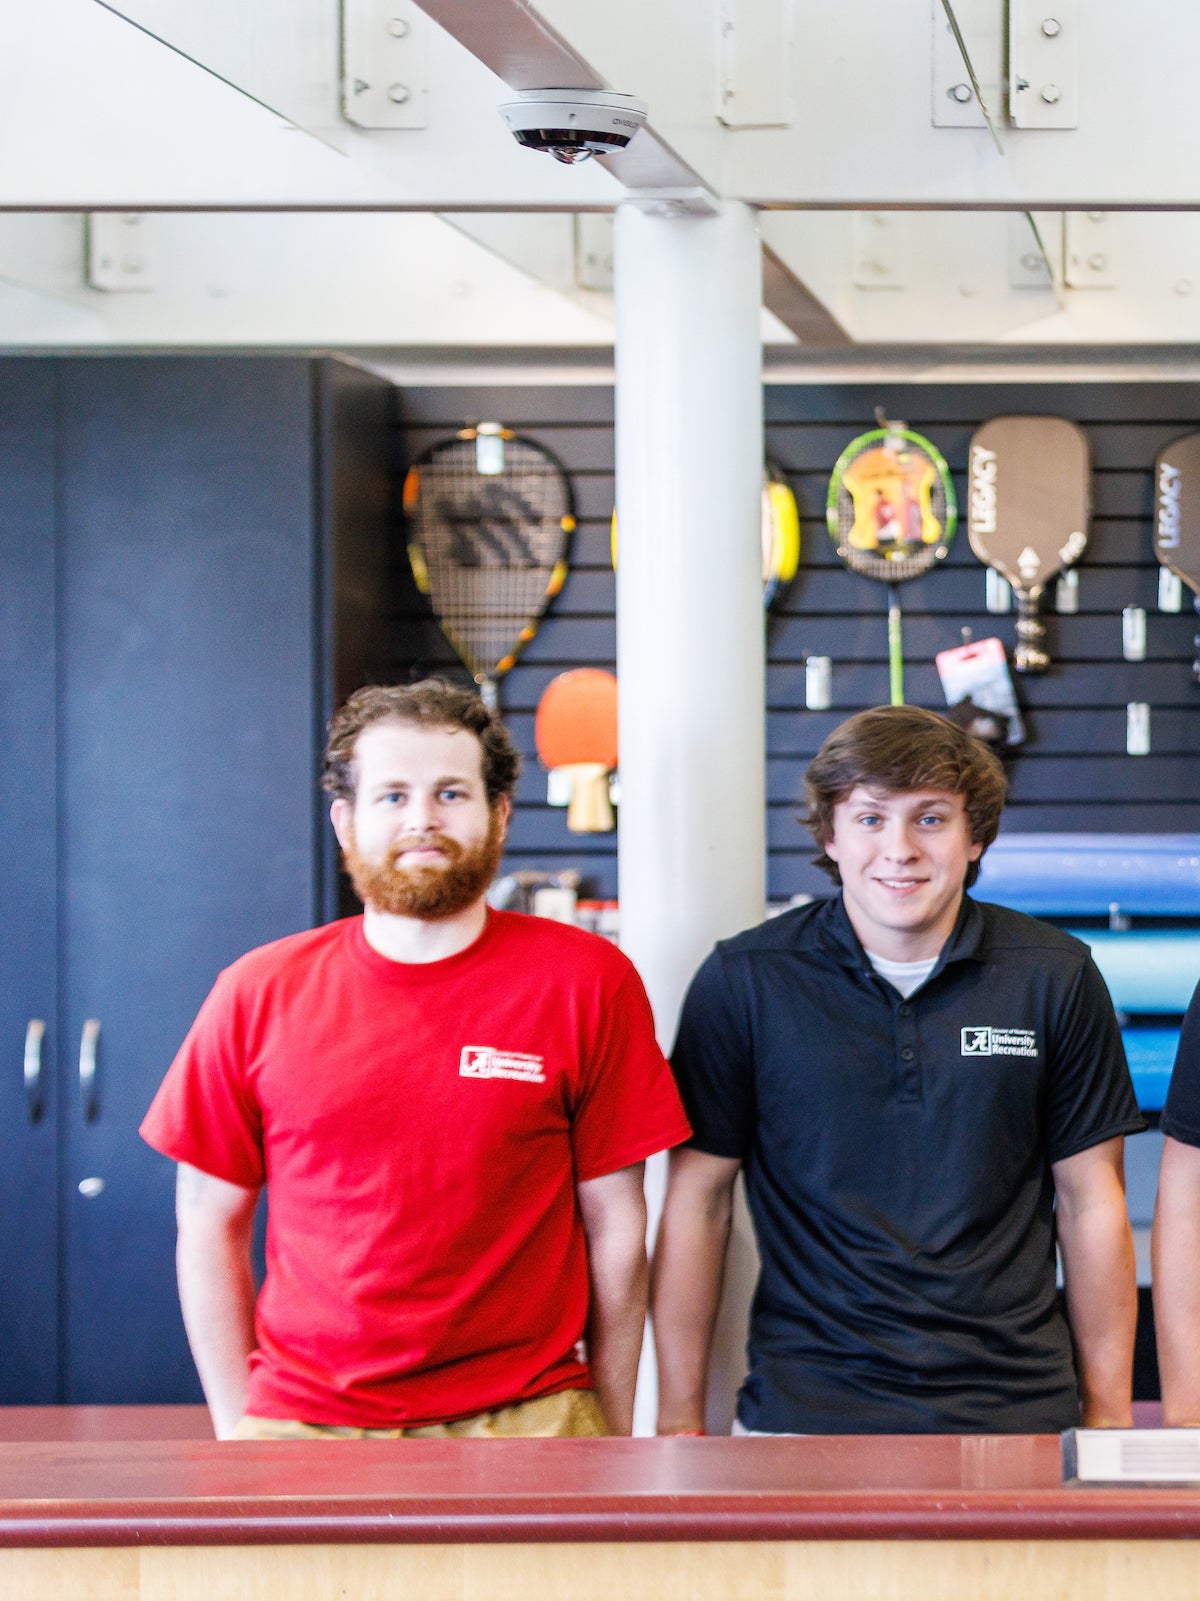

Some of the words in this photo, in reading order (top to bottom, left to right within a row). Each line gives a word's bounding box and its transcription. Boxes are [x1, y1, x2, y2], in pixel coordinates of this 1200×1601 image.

[971, 445, 997, 533] LEGACY
[1158, 462, 1181, 548] LEGACY
[992, 1034, 1035, 1049] University
[993, 1044, 1038, 1057] Recreation
